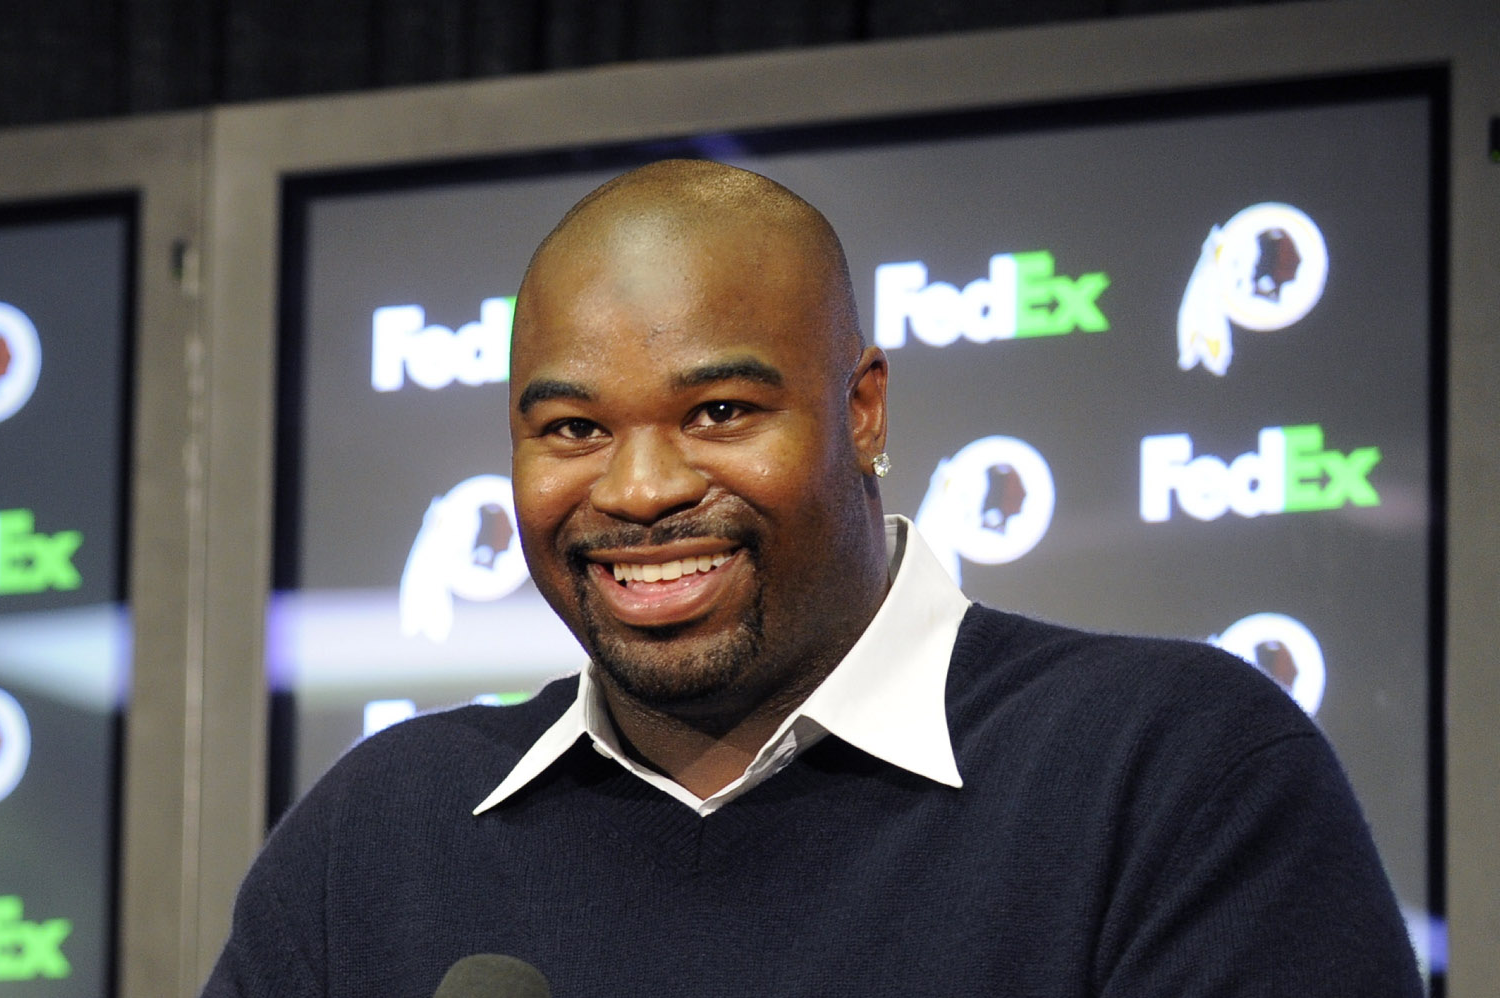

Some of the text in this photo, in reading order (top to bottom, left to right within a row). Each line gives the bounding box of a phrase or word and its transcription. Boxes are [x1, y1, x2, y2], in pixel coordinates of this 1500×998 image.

[372, 296, 517, 392] Fed
[874, 251, 1109, 353] FedEx
[1139, 425, 1381, 523] FedEx
